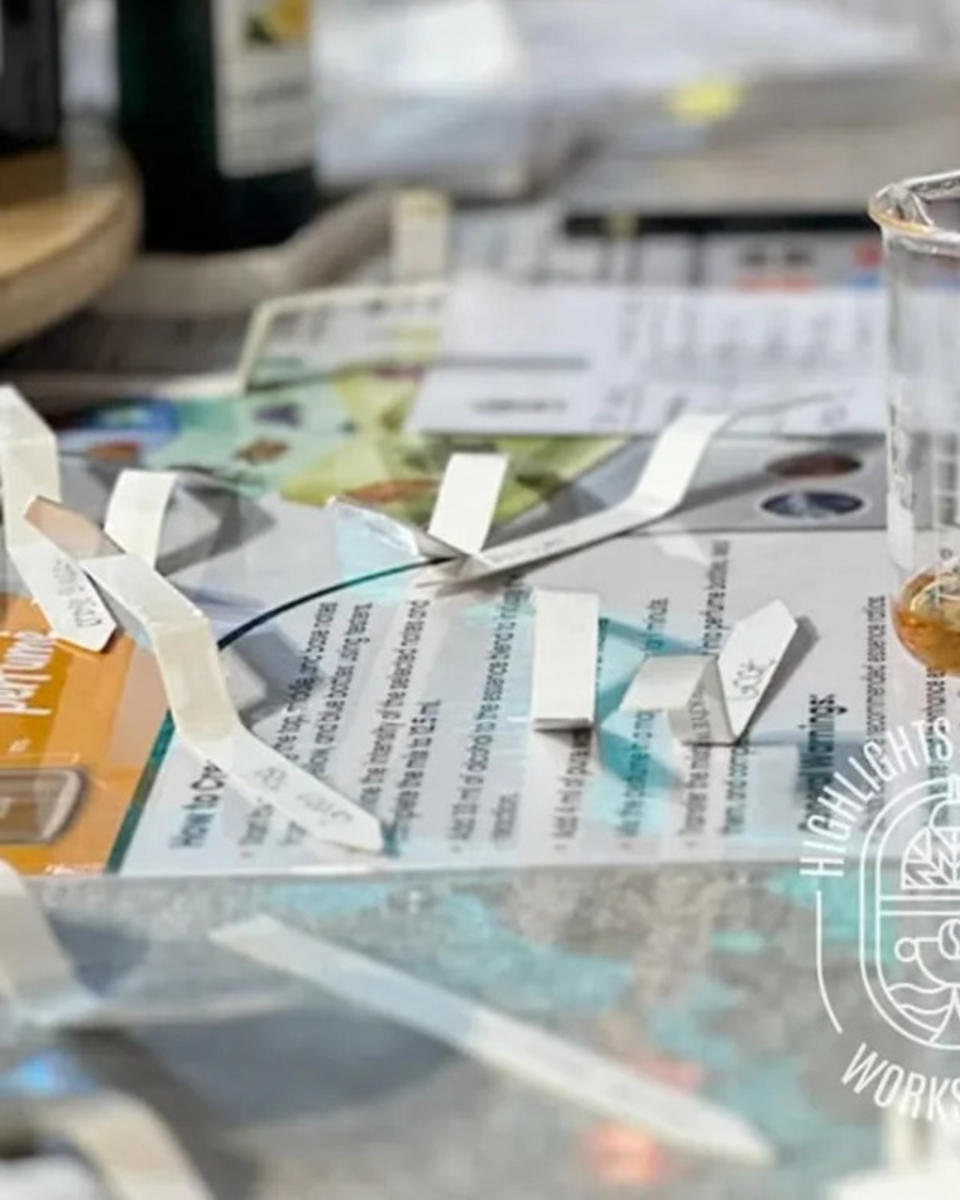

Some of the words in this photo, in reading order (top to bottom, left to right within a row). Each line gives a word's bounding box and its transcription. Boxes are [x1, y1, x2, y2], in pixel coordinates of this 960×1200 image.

[312, 602, 338, 628] notes
[405, 599, 430, 619] and
[698, 592, 730, 630] perfume
[302, 630, 330, 652] base
[398, 621, 422, 646] notes
[866, 624, 887, 663] essence
[336, 638, 369, 662] using
[483, 633, 514, 661] blend
[297, 656, 319, 674] and
[386, 648, 415, 690] selected
[324, 666, 355, 697] bottles
[480, 662, 509, 701] essence
[381, 691, 407, 707] the
[860, 664, 887, 737] recommended
[316, 701, 345, 722] blue
[473, 704, 498, 721] the
[311, 724, 338, 743] and
[472, 723, 495, 733] to
[798, 694, 848, 769] Warnings:
[272, 735, 299, 749] the
[366, 722, 405, 764] intensity
[408, 738, 433, 748] to
[402, 751, 426, 769] mix
[460, 734, 491, 772] alcohol
[360, 768, 386, 784] the
[398, 771, 424, 787] the
[682, 771, 709, 790] the
[722, 780, 747, 801] and
[183, 794, 220, 809] to
[175, 813, 213, 849] How
